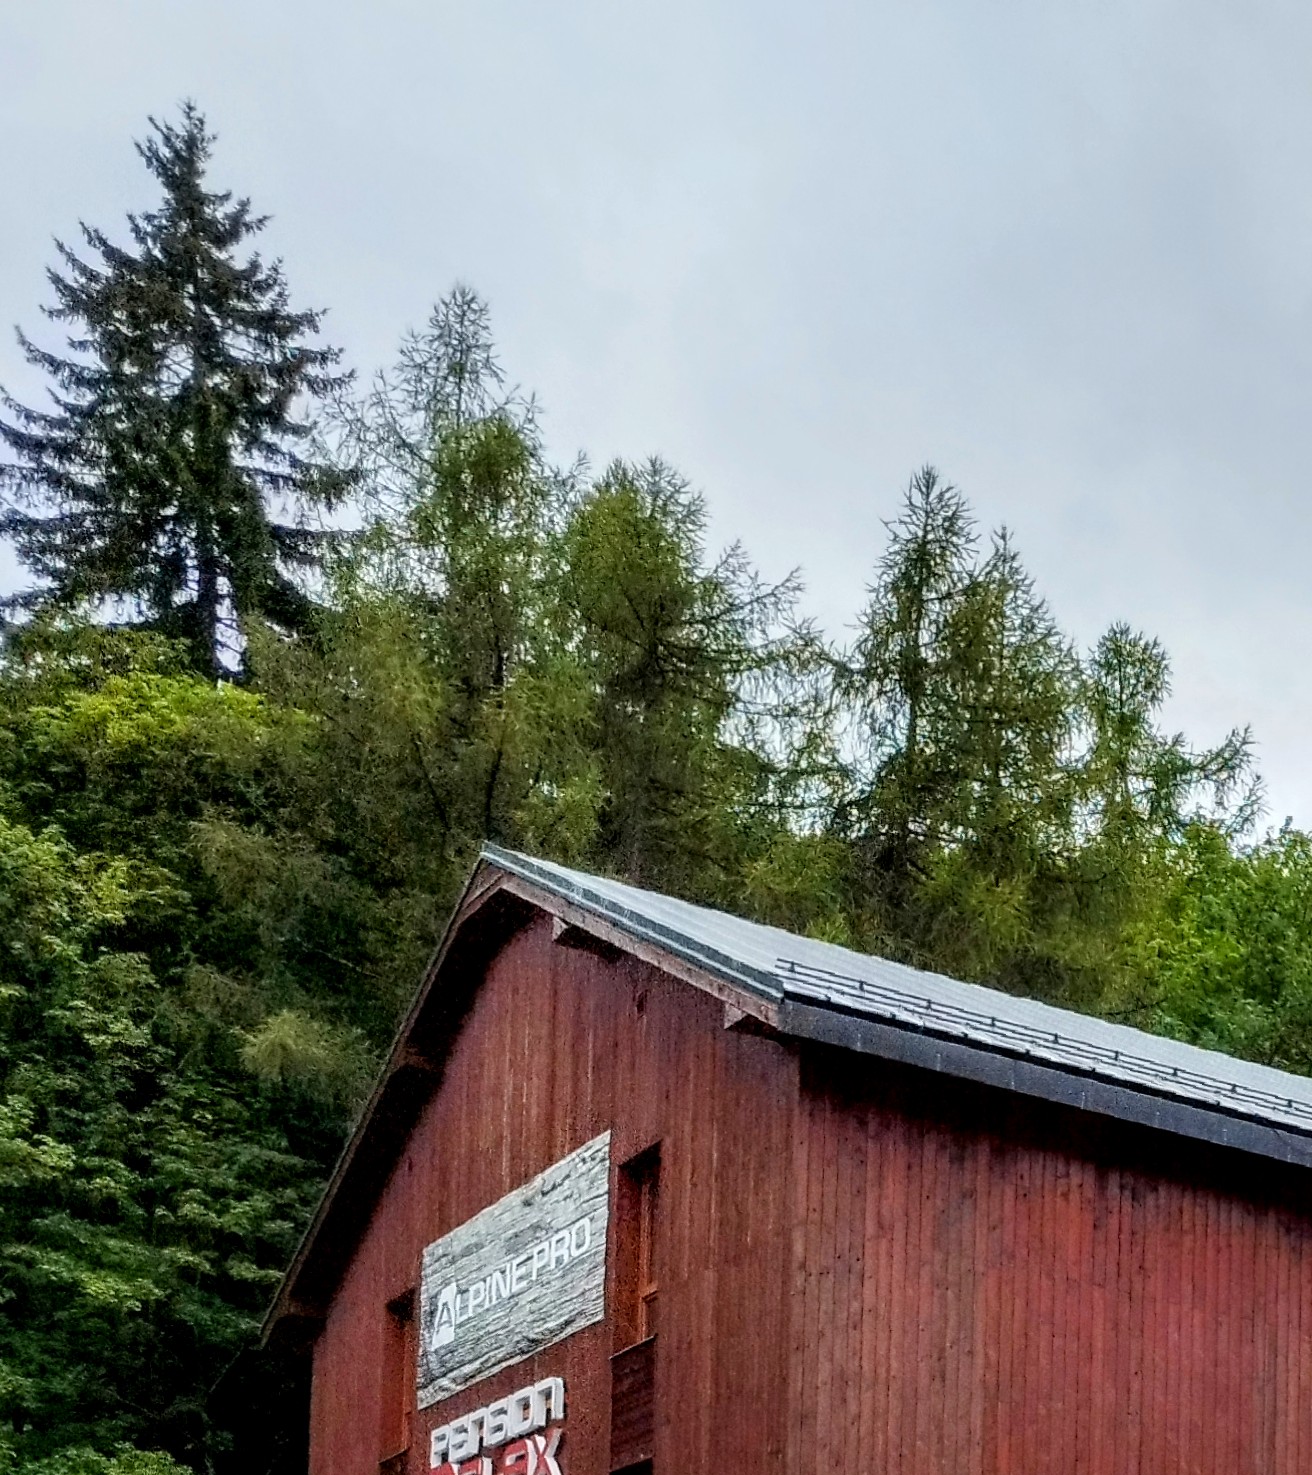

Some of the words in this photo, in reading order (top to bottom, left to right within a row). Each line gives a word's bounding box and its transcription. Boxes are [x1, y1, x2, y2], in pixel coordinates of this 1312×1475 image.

[432, 1254, 530, 1351] ALPINE
[531, 1217, 592, 1281] PRO
[430, 1377, 565, 1469] PENSION
